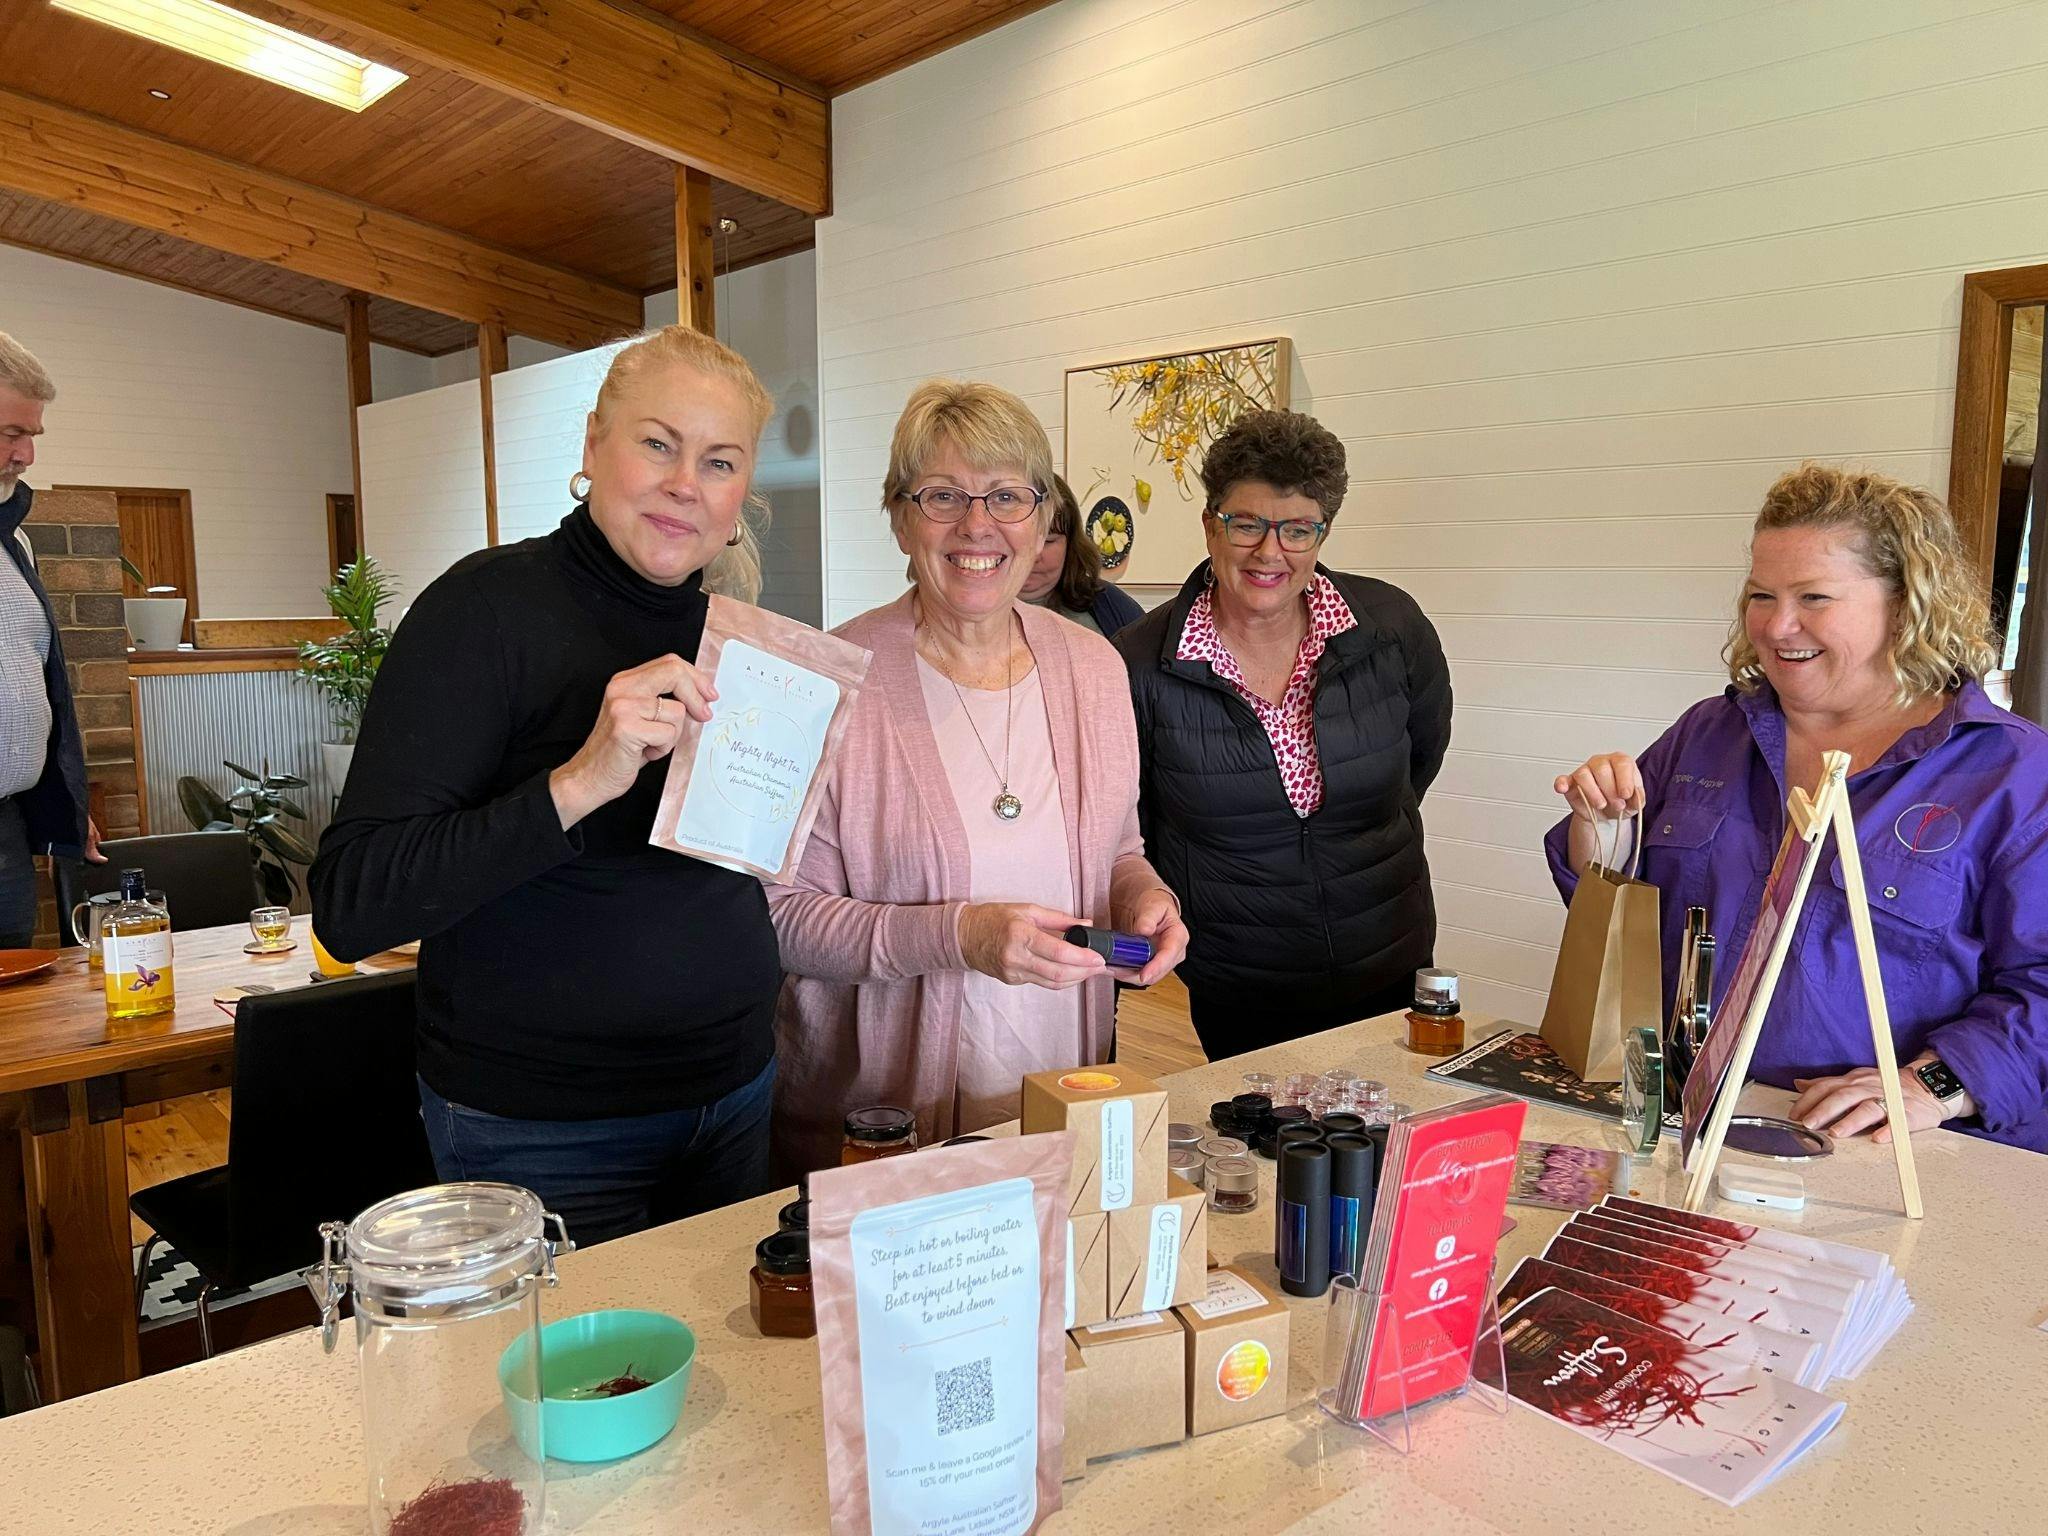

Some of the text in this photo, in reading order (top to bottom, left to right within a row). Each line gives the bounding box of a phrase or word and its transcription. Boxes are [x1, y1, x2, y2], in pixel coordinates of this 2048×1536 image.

[726, 763, 761, 777] Australian
[730, 741, 801, 774] Nighty Night Tea
[730, 776, 763, 791] Australian
[871, 1218, 1023, 1267] Steep in hot or boiling water
[884, 1265, 1025, 1312] Best enjoyed before bed or
[892, 1268, 911, 1291] for
[912, 1265, 927, 1278] at
[928, 1256, 956, 1274] least
[956, 1254, 963, 1267] 5
[922, 1297, 996, 1324] to wind down
[1542, 1335, 1627, 1386] Saffron
[1594, 1360, 1653, 1405] COOKING WITH
[885, 1467, 909, 1479] Scan
[911, 1464, 927, 1474] me
[929, 1462, 936, 1471] &
[938, 1456, 964, 1470] leave
[965, 1456, 971, 1464] a
[972, 1446, 1003, 1462] Google
[919, 1454, 1016, 1488] 15% off your next order
[921, 1514, 950, 1530] Argyle
[952, 1504, 992, 1524] Australian
[993, 1494, 1018, 1509] Saffron
